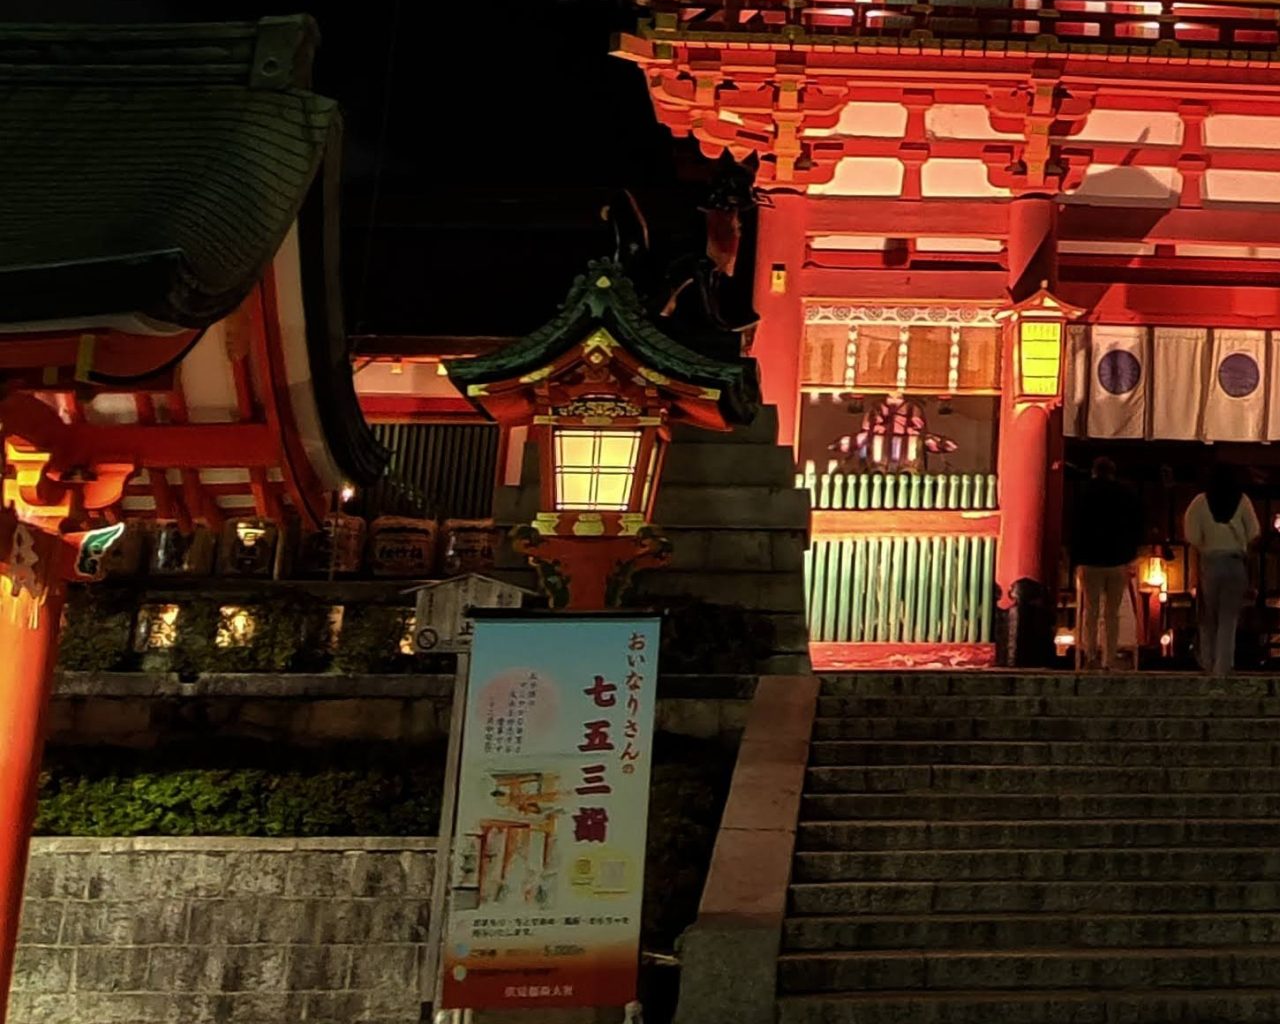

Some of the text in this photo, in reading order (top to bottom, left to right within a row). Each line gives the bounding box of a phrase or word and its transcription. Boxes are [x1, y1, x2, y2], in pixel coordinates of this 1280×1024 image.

[619, 632, 646, 775] おいなりさんの
